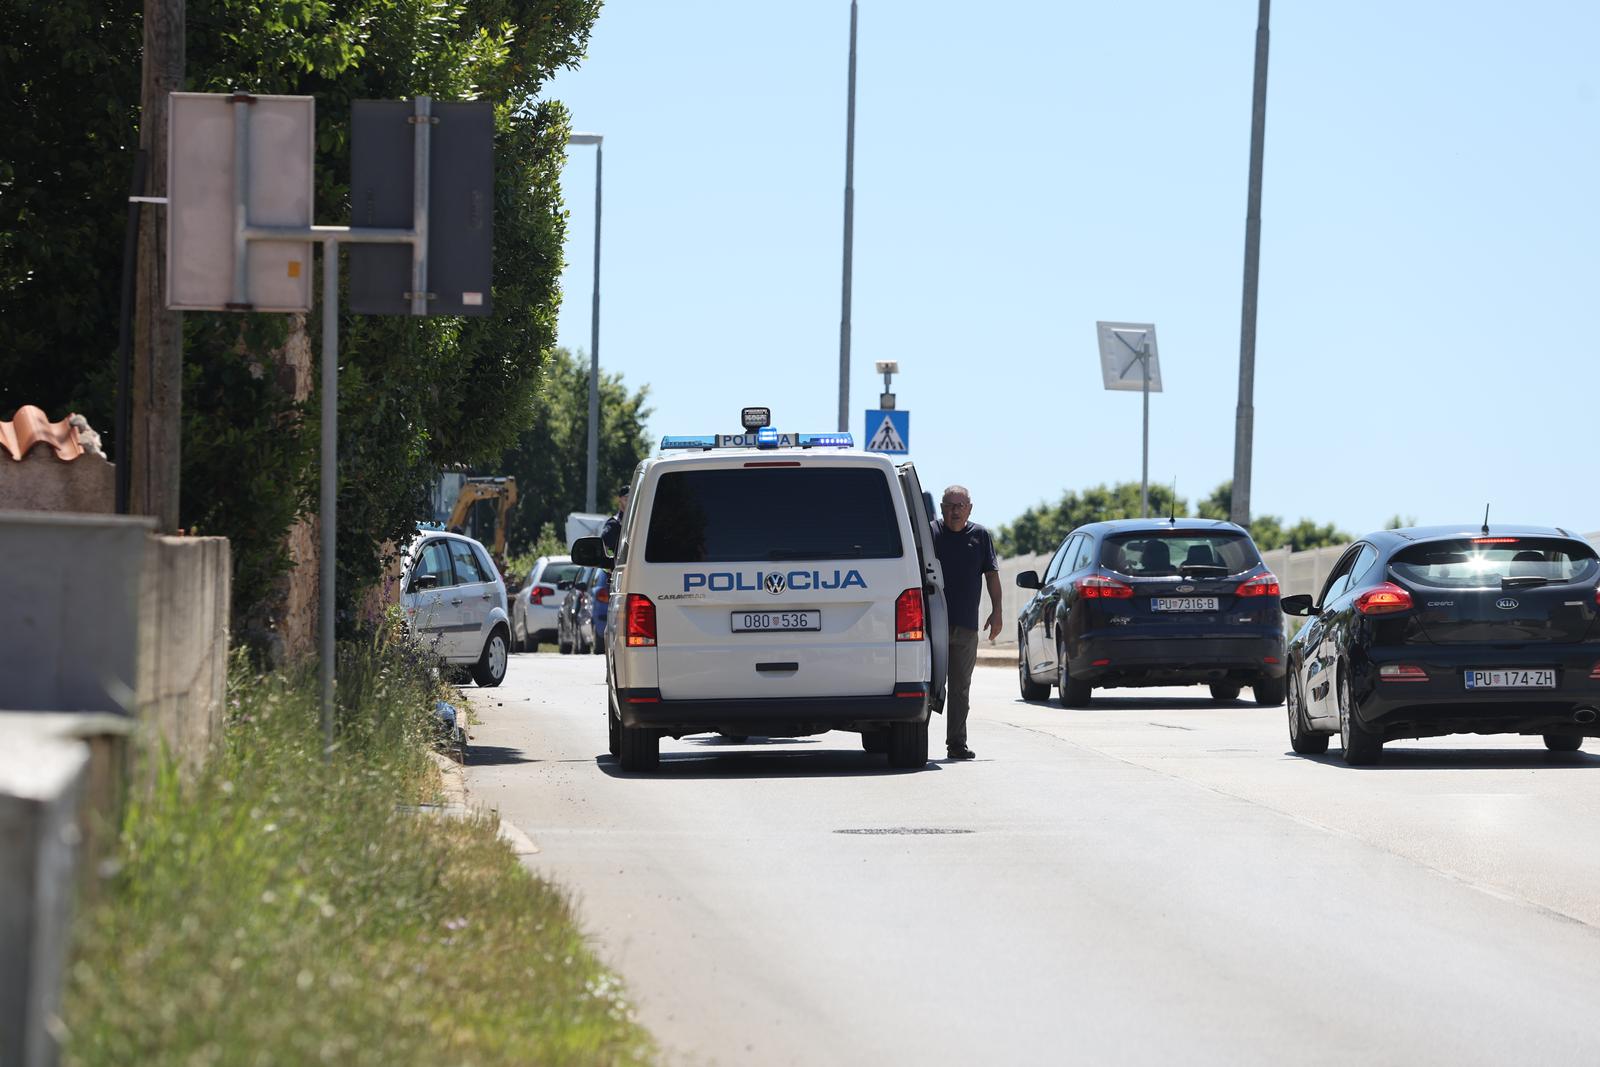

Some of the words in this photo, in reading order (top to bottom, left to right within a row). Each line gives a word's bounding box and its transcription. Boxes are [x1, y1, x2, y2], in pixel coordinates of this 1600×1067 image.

[723, 434, 791, 446] POLIA
[1159, 599, 1172, 609] PU
[1178, 598, 1214, 609] 7316-B
[744, 614, 770, 628] 080
[782, 613, 808, 628] 536
[1475, 672, 1492, 686] PU
[1504, 671, 1553, 686] 174-ZH
